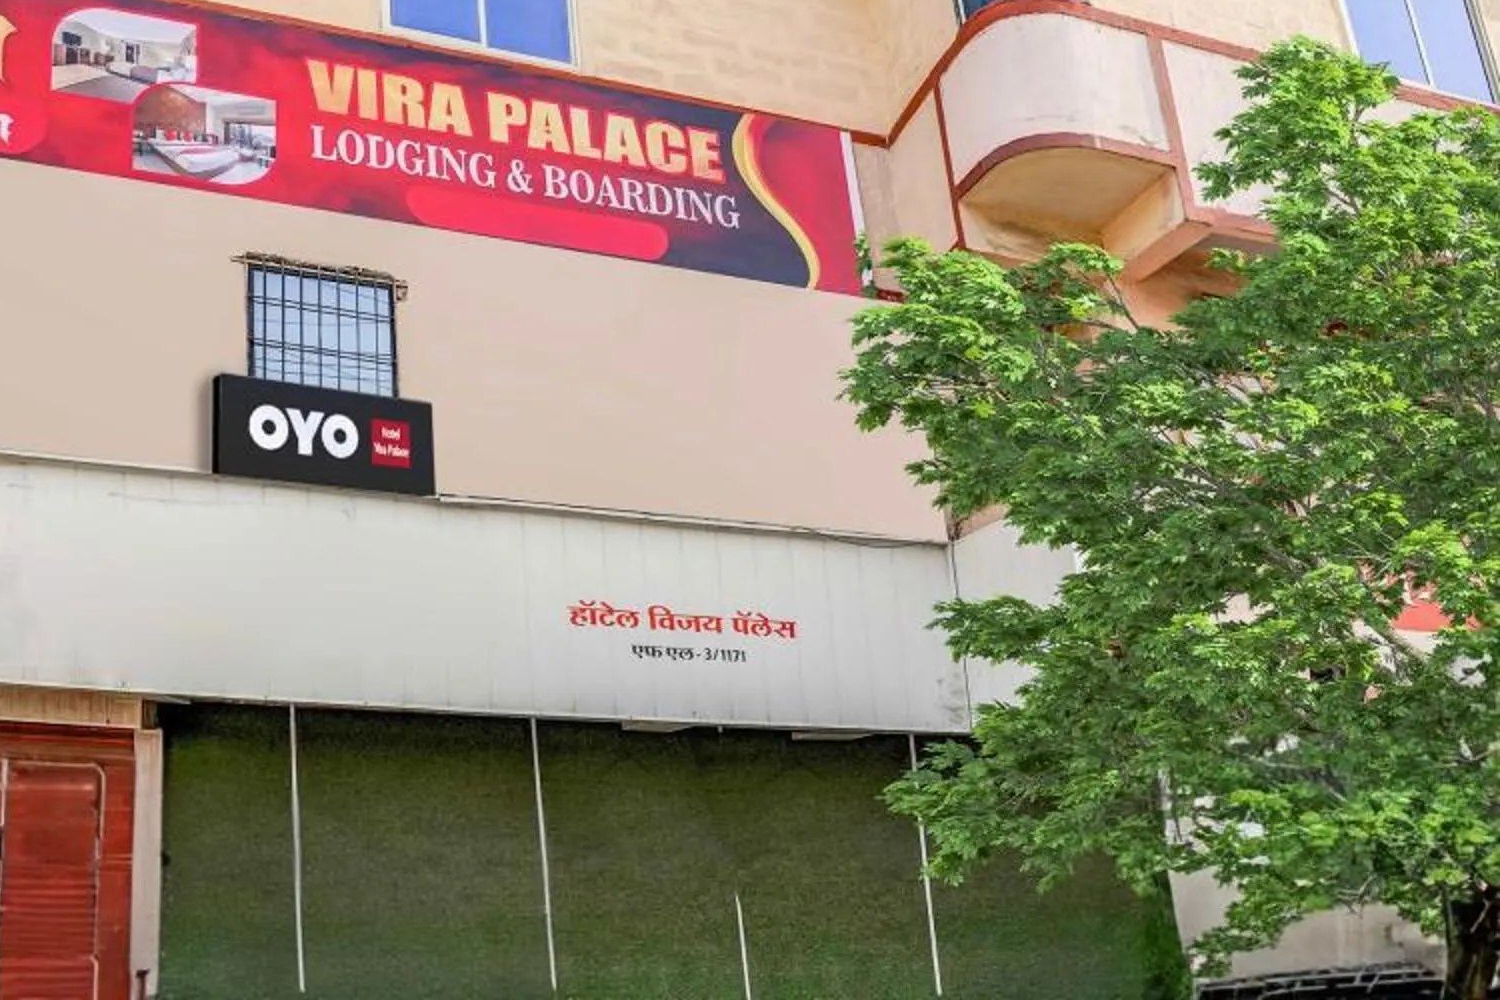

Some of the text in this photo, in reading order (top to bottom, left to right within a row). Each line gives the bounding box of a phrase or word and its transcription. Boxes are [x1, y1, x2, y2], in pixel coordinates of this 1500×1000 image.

[307, 58, 725, 184] VIRA PALACE
[310, 125, 741, 230] LODGING & BOARDING
[248, 404, 359, 460] OYO
[568, 599, 798, 640] हॉटेल विजय पॅलेस
[631, 644, 663, 659] एफ
